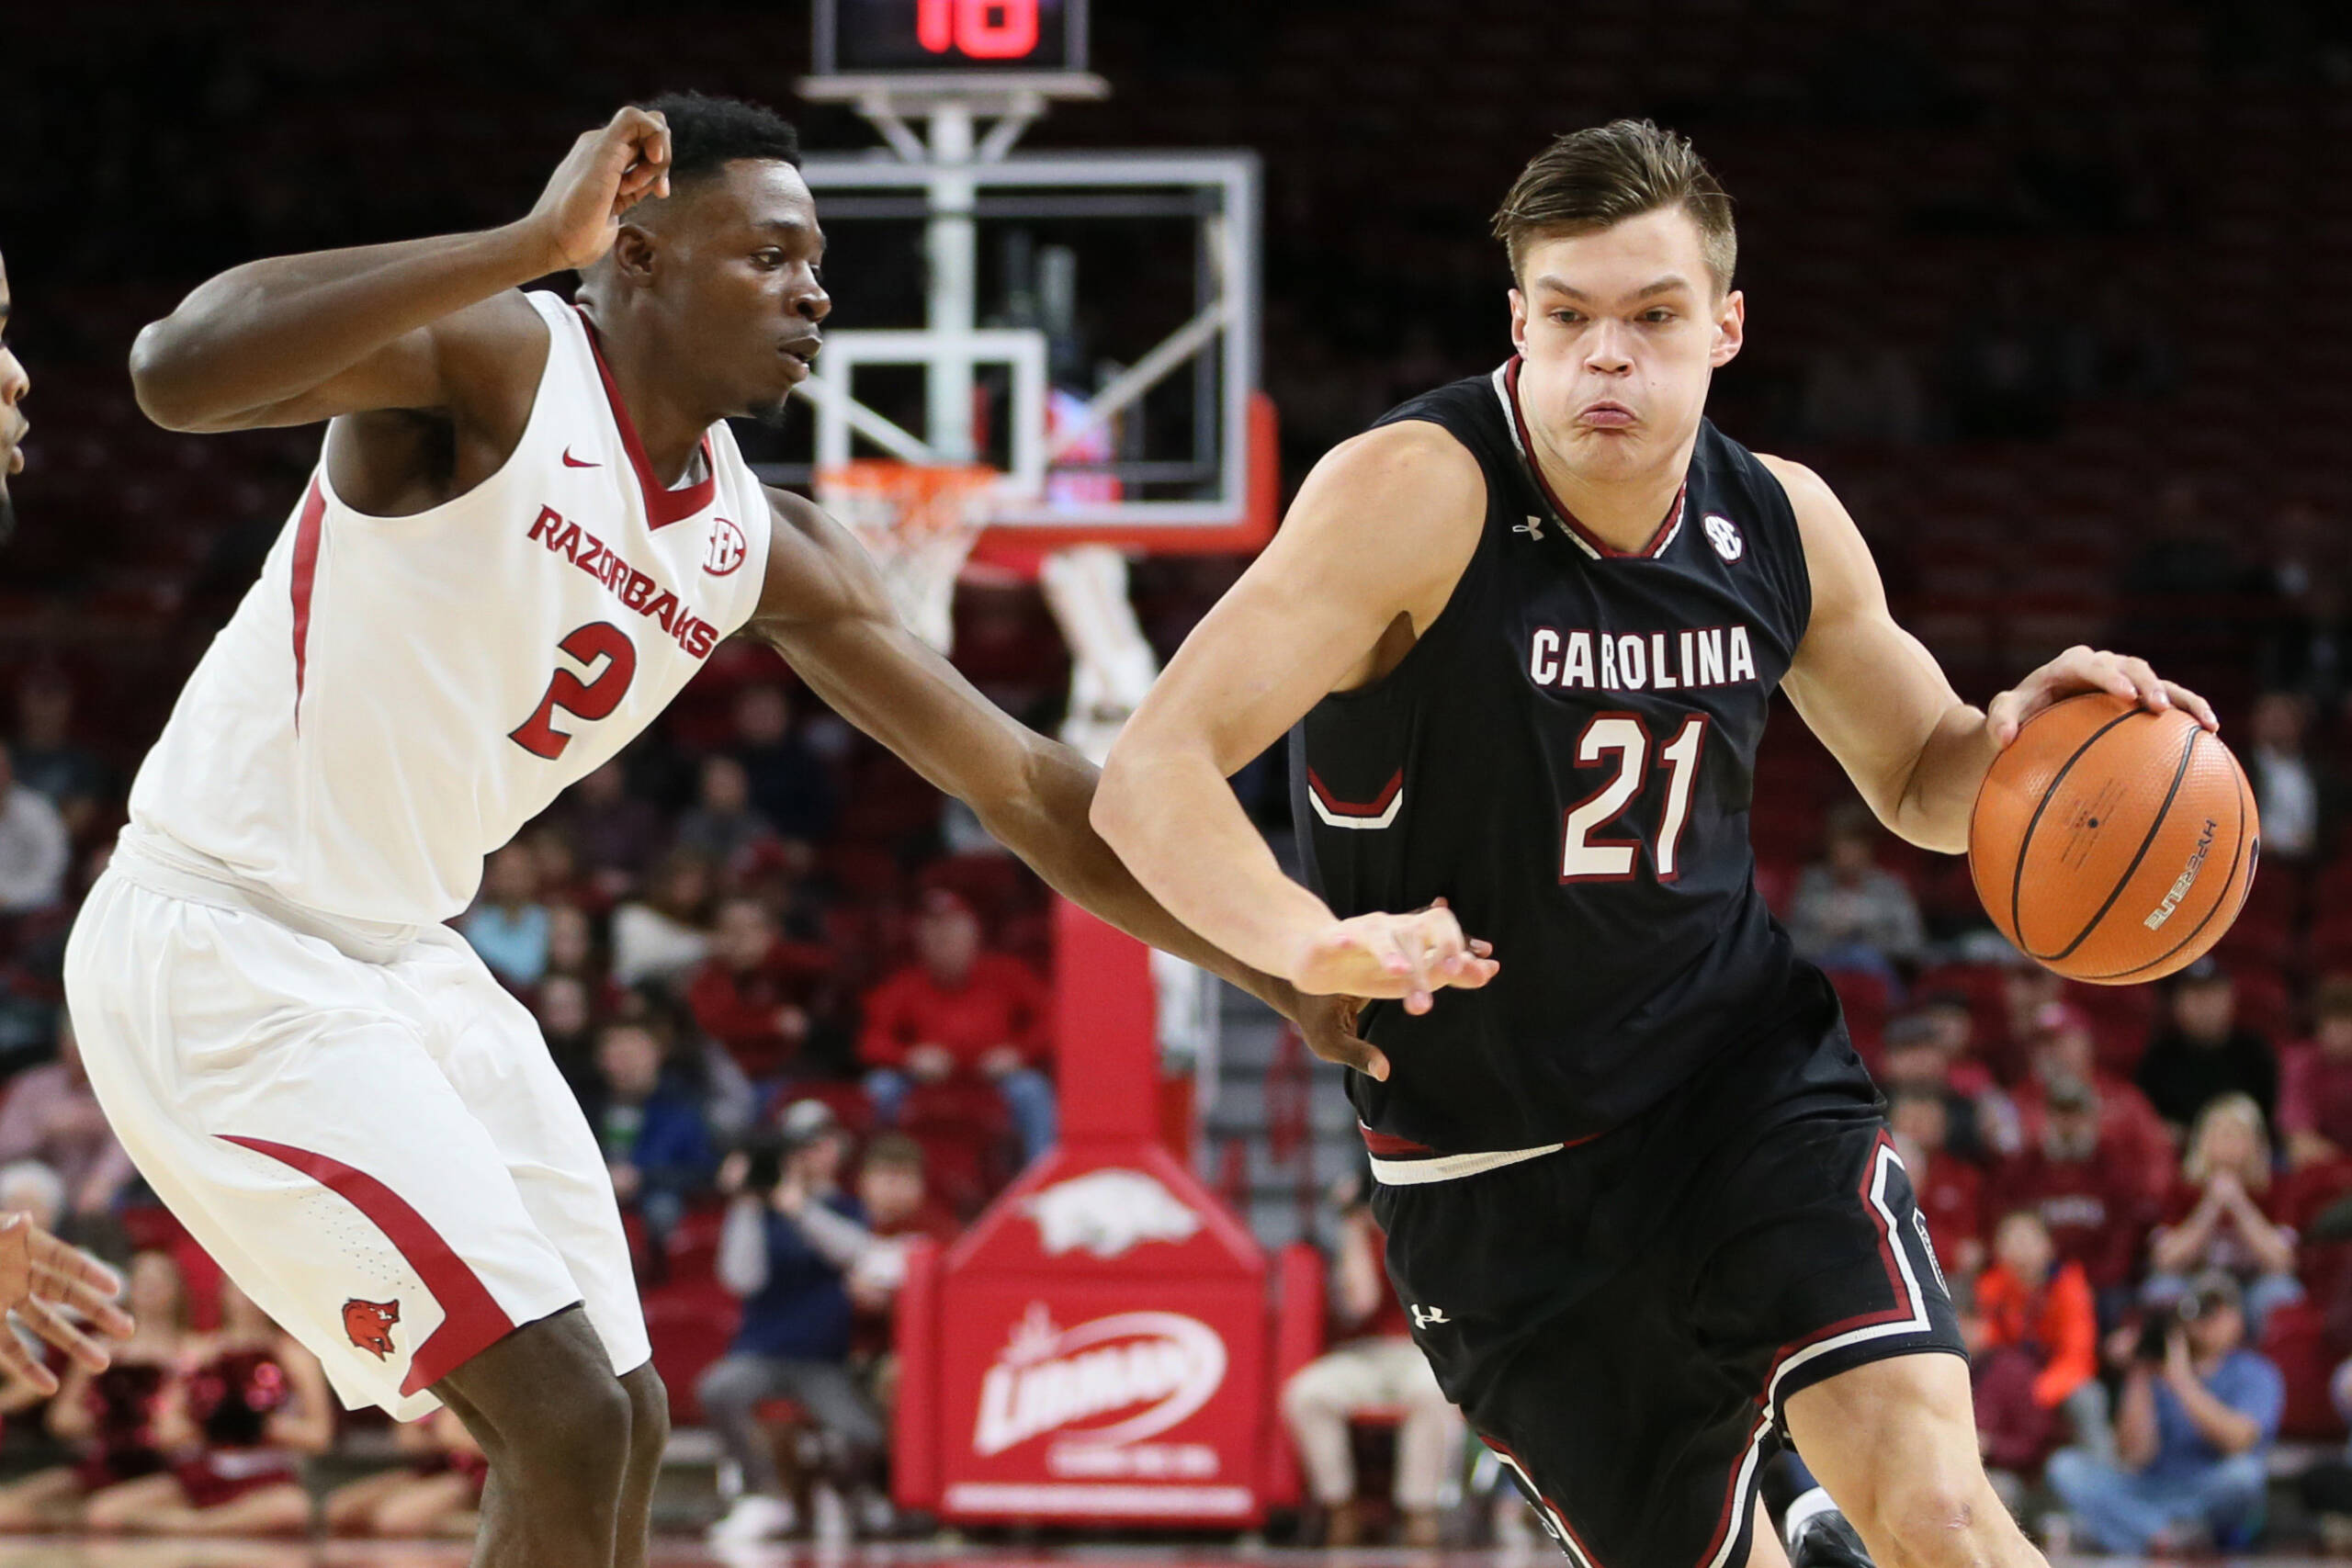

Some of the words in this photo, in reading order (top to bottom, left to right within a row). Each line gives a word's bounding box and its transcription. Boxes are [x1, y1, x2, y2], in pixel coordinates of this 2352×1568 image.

[526, 503, 719, 660] RAZORBAKS
[1702, 513, 1745, 563] SEC
[507, 621, 637, 761] 2
[1530, 626, 1758, 691] CAROLINA
[1559, 711, 1710, 885] 21
